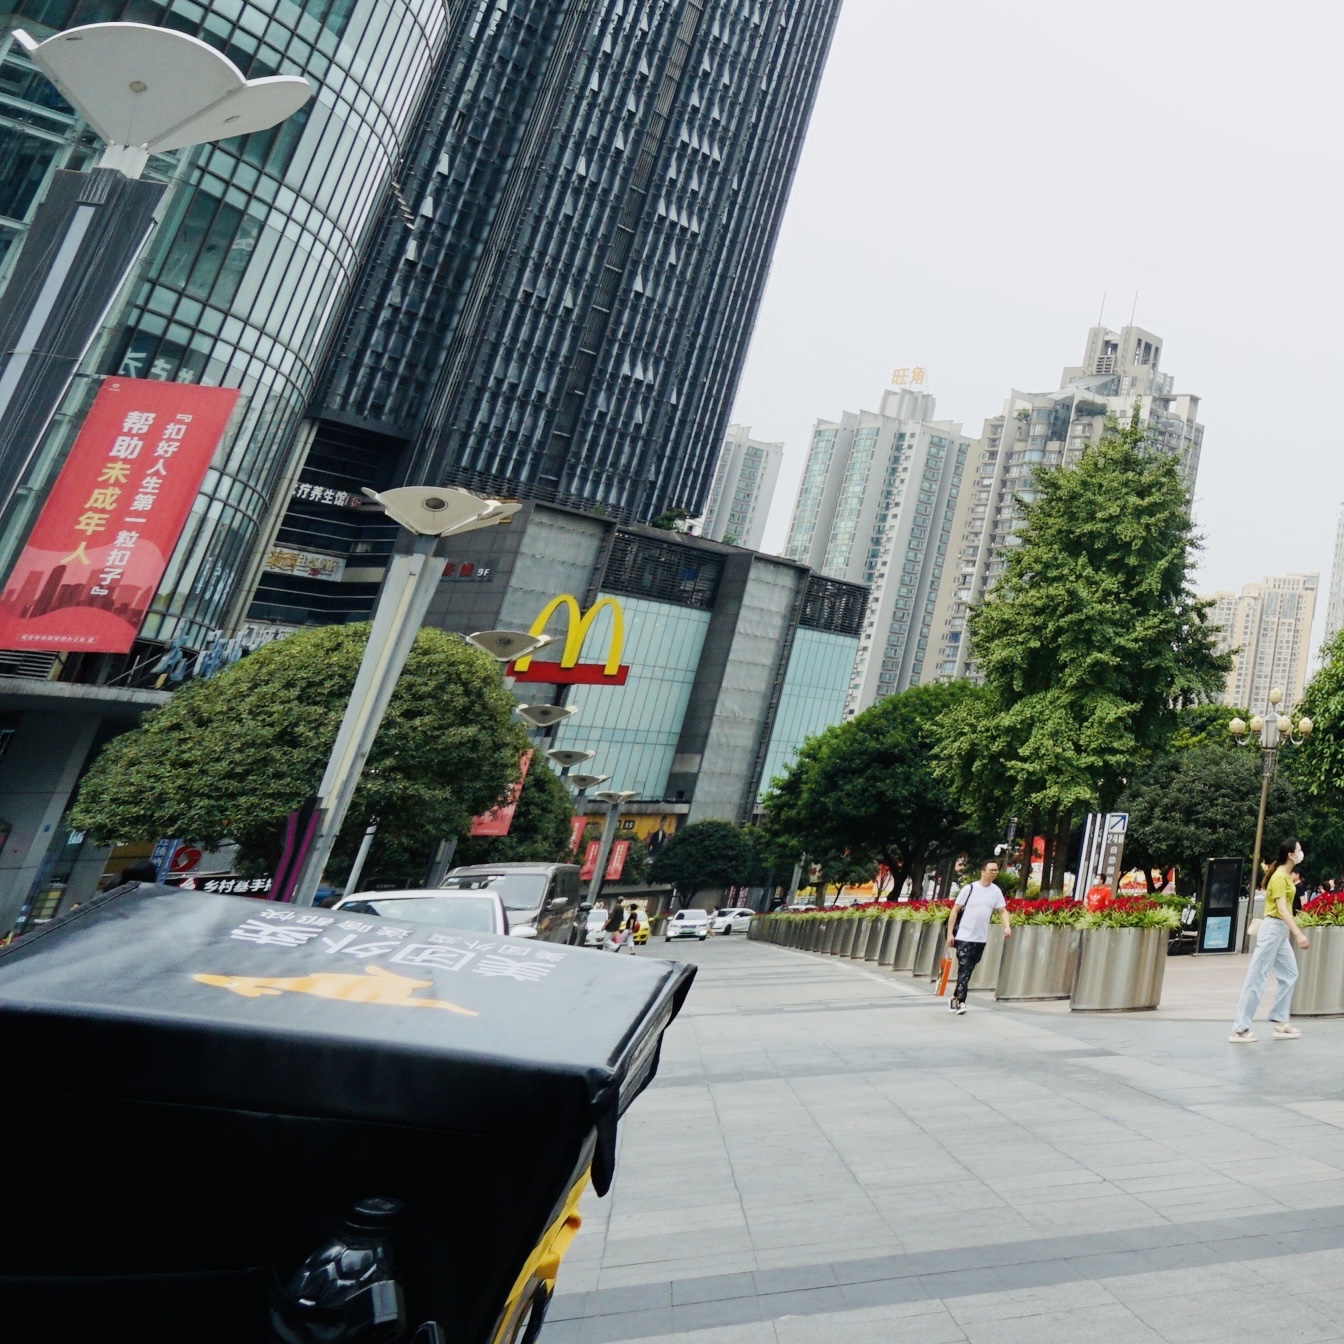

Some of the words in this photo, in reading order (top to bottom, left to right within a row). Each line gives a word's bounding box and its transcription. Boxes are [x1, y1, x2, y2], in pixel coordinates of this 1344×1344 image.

[60, 411, 156, 566] 帮助未成年人
[259, 908, 414, 938] 送啥都快
[231, 919, 556, 982] 美团外卖
[430, 933, 567, 962] 美团外卖
